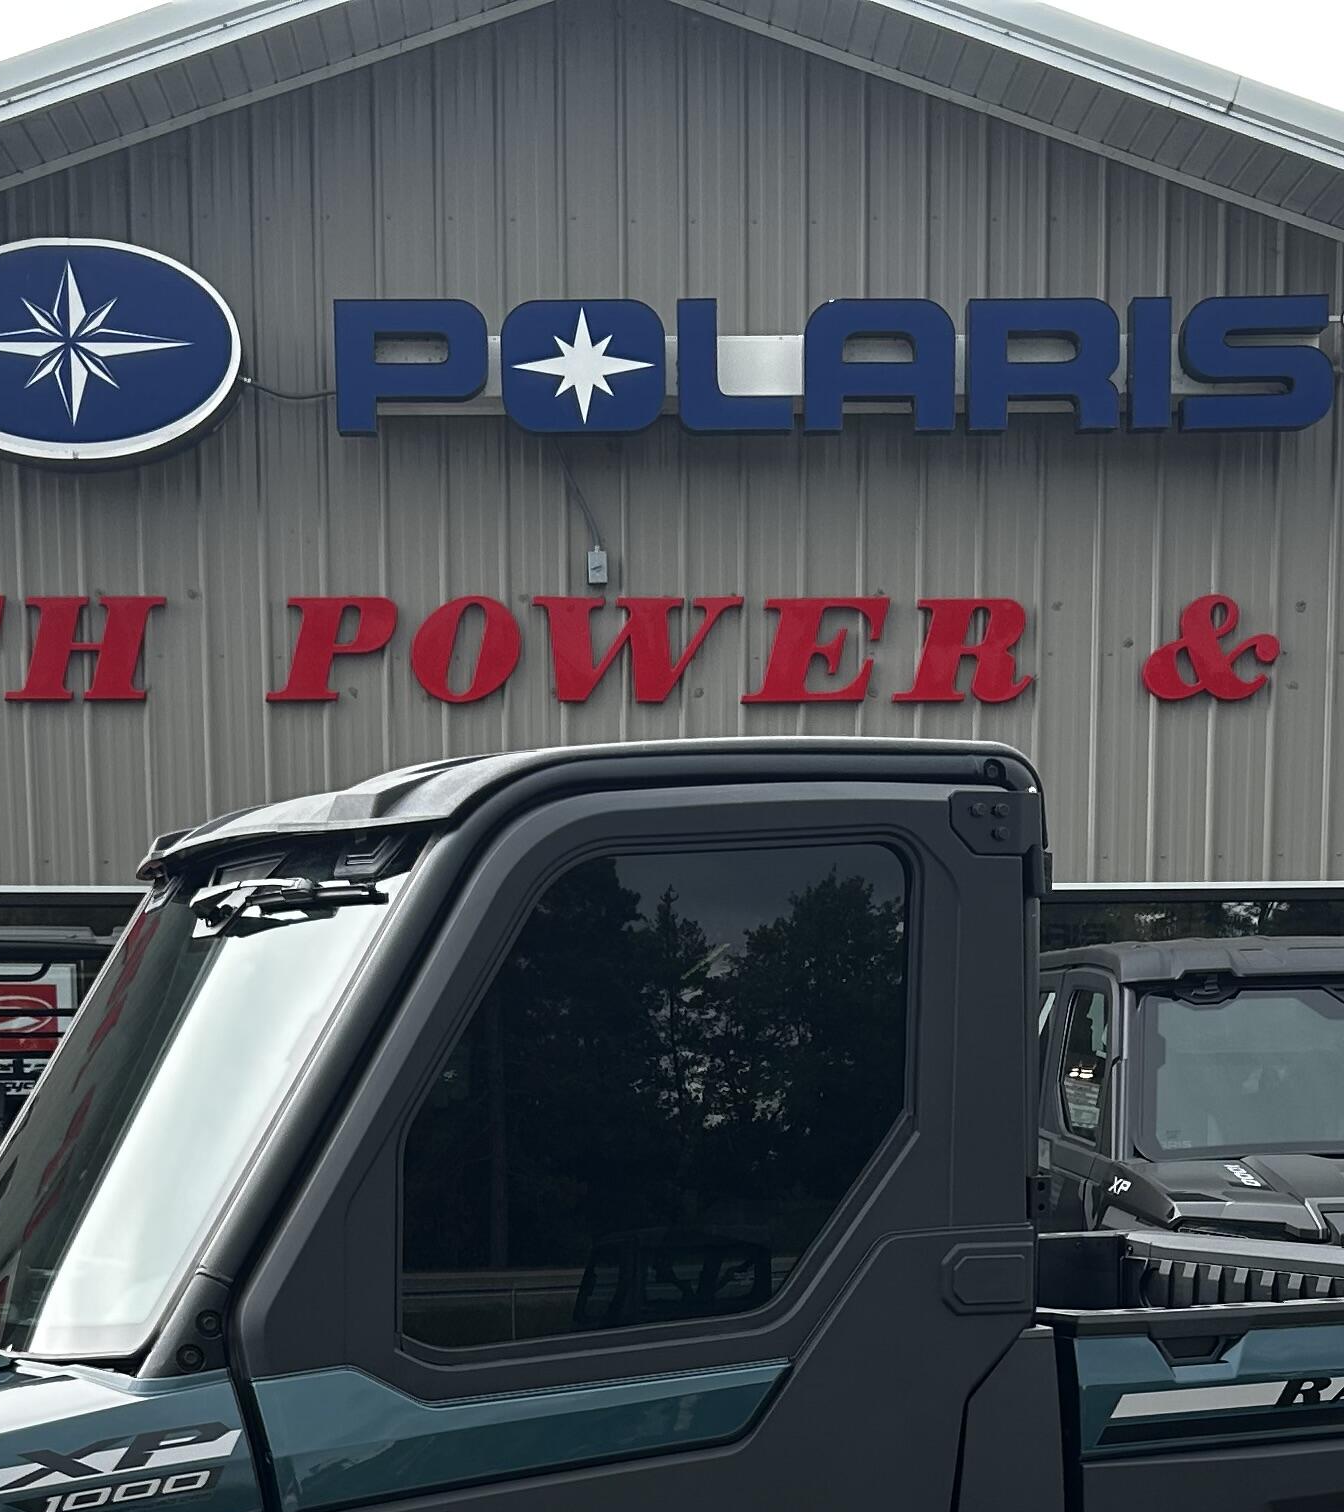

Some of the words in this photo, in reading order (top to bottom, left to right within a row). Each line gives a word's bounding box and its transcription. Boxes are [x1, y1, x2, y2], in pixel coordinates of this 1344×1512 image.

[334, 294, 1332, 436] POLARIS
[264, 595, 1039, 704] POWER
[1142, 592, 1280, 702] &
[1108, 1176, 1131, 1195] XP
